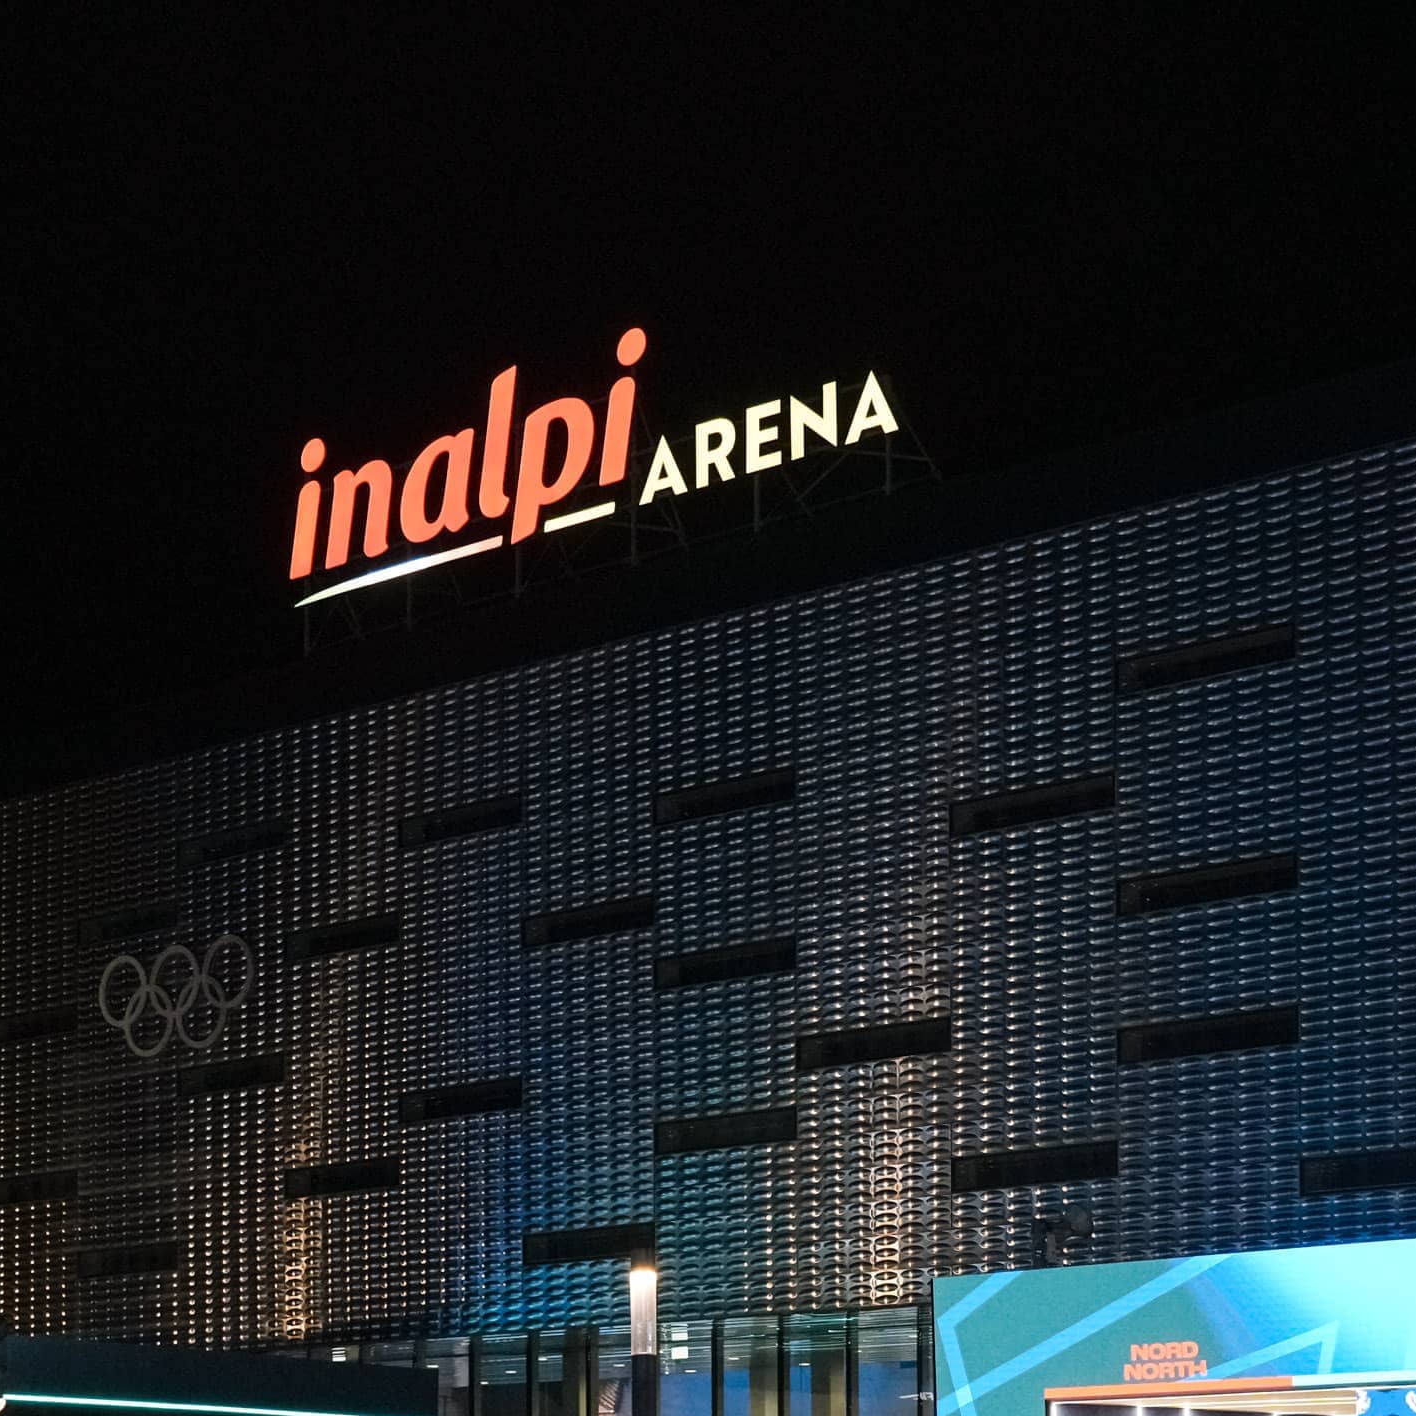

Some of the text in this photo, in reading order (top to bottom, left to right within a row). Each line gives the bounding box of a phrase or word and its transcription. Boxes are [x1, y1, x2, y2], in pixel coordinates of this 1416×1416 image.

[289, 327, 900, 580] inalpi ARENA
[1130, 1341, 1199, 1361] NORD
[1124, 1360, 1208, 1381] NORTH
